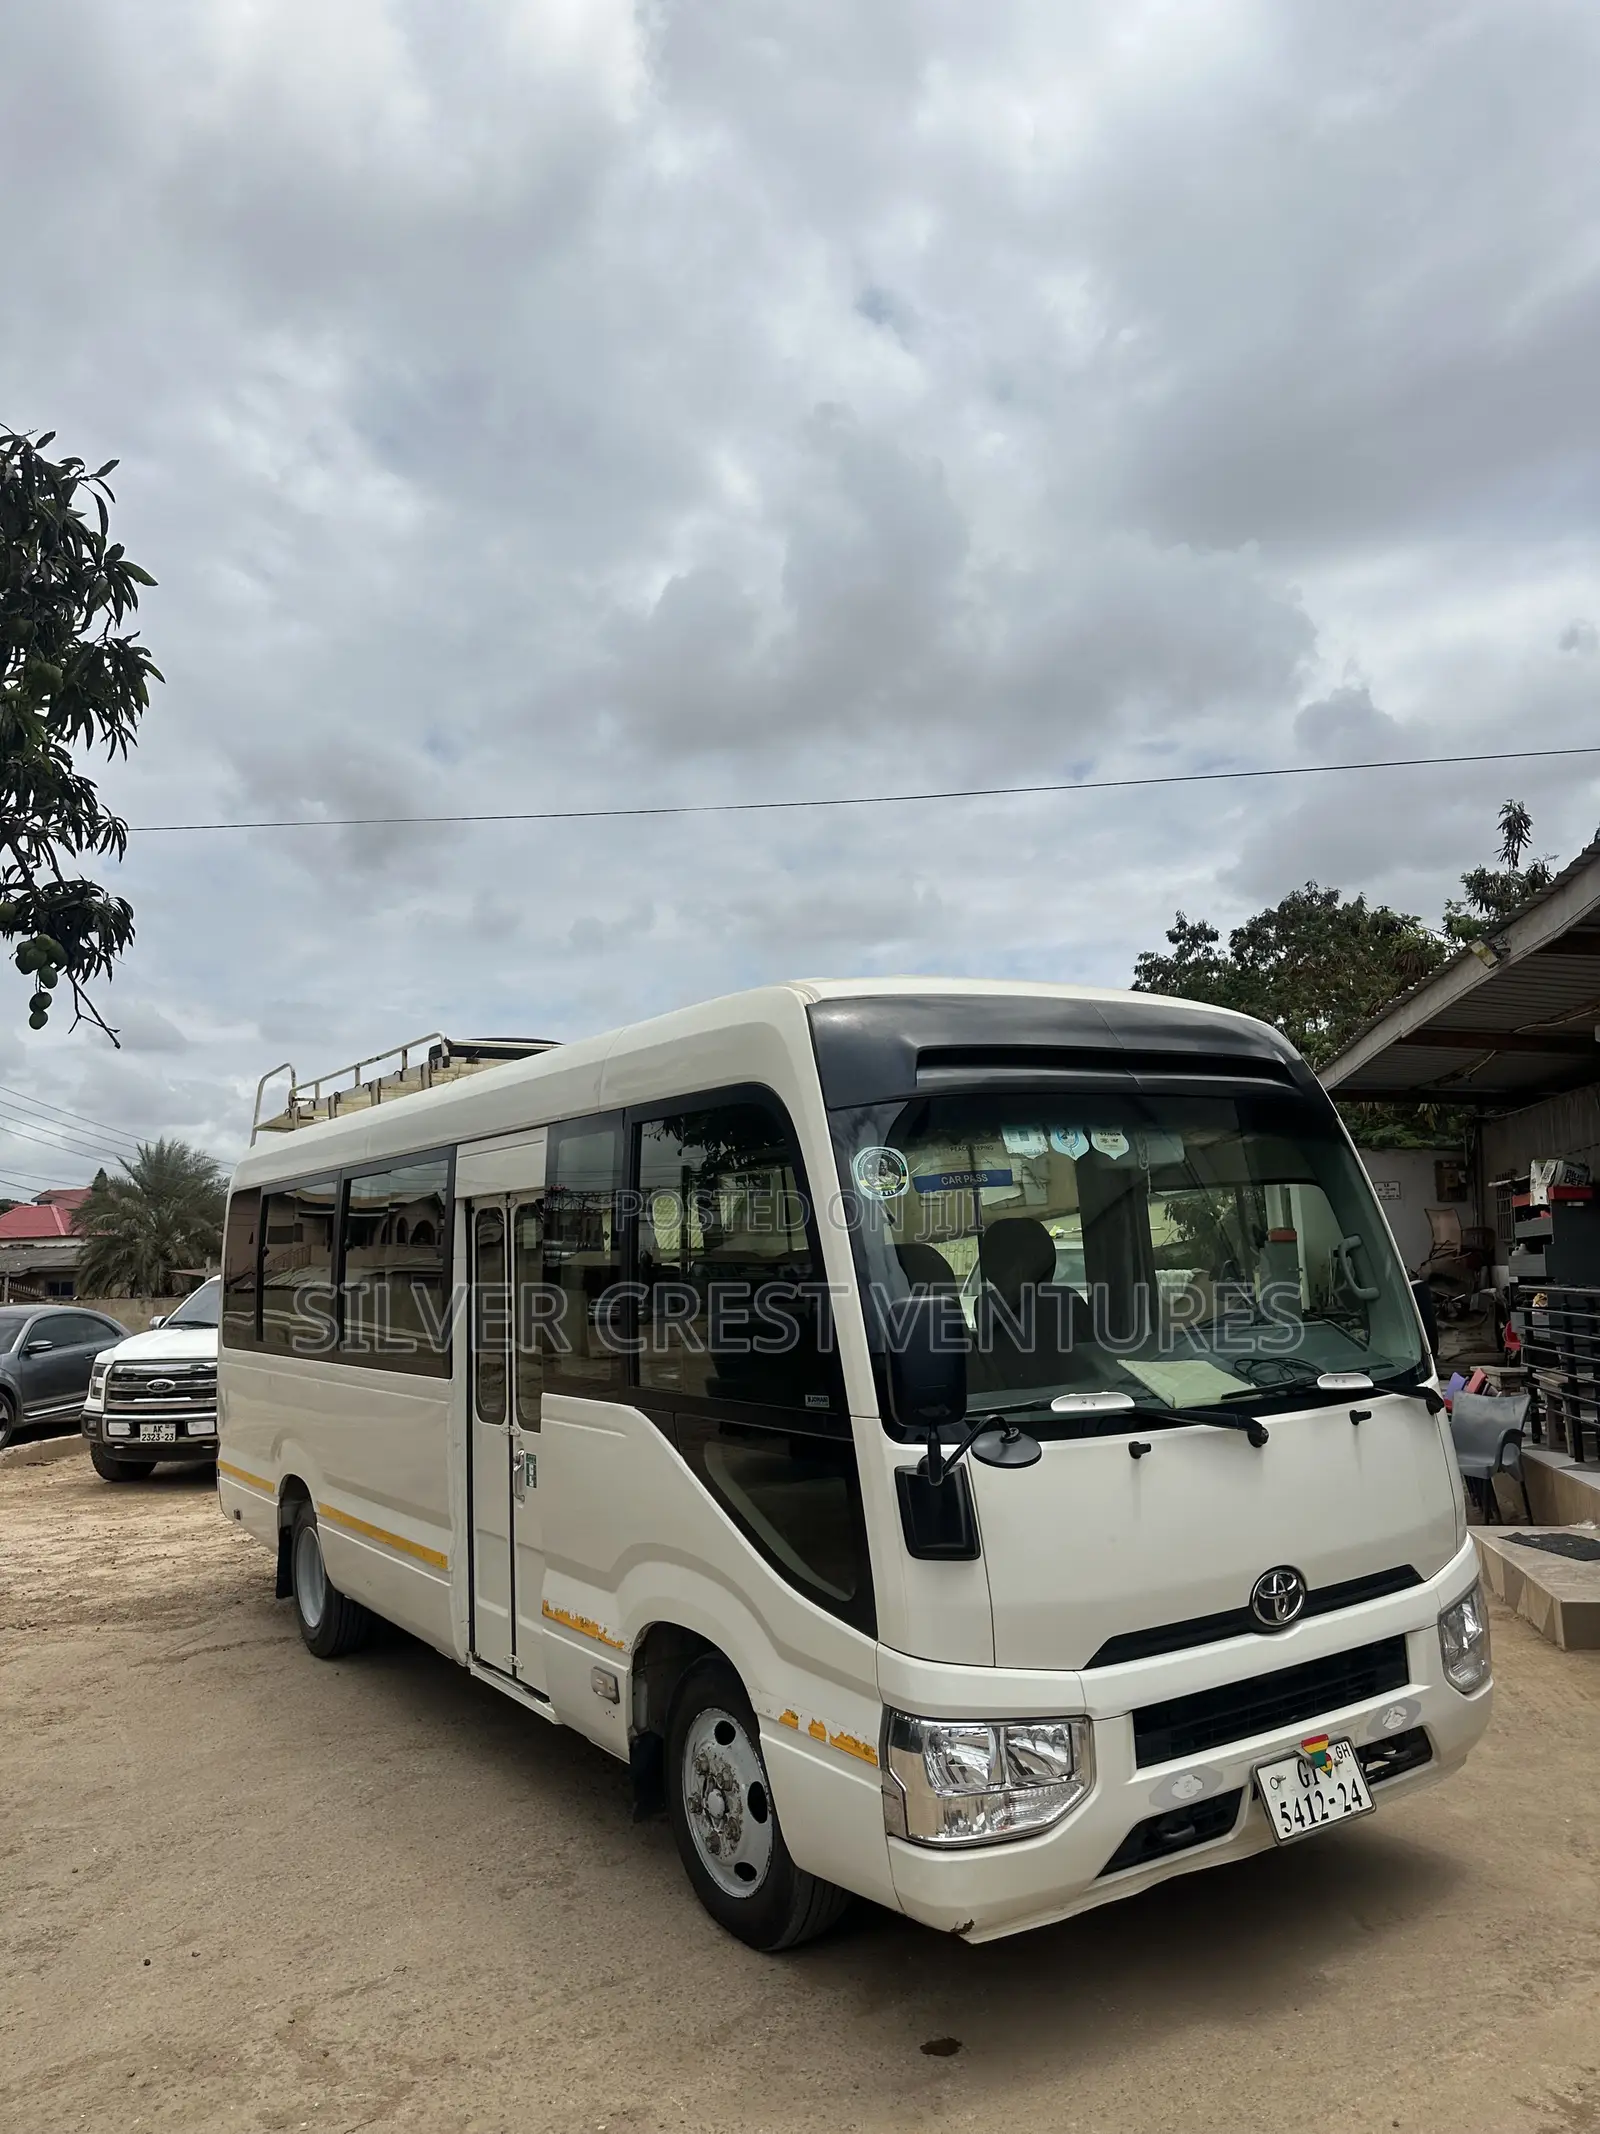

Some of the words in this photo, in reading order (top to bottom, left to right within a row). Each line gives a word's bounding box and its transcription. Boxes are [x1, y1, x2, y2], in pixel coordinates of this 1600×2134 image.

[941, 1175, 963, 1185] CAR
[963, 1173, 989, 1183] PASS
[153, 1425, 163, 1433] AK
[142, 1433, 174, 1442] 2323-23
[1335, 1743, 1351, 1760] GH
[1280, 1778, 1362, 1833] 5412-24
